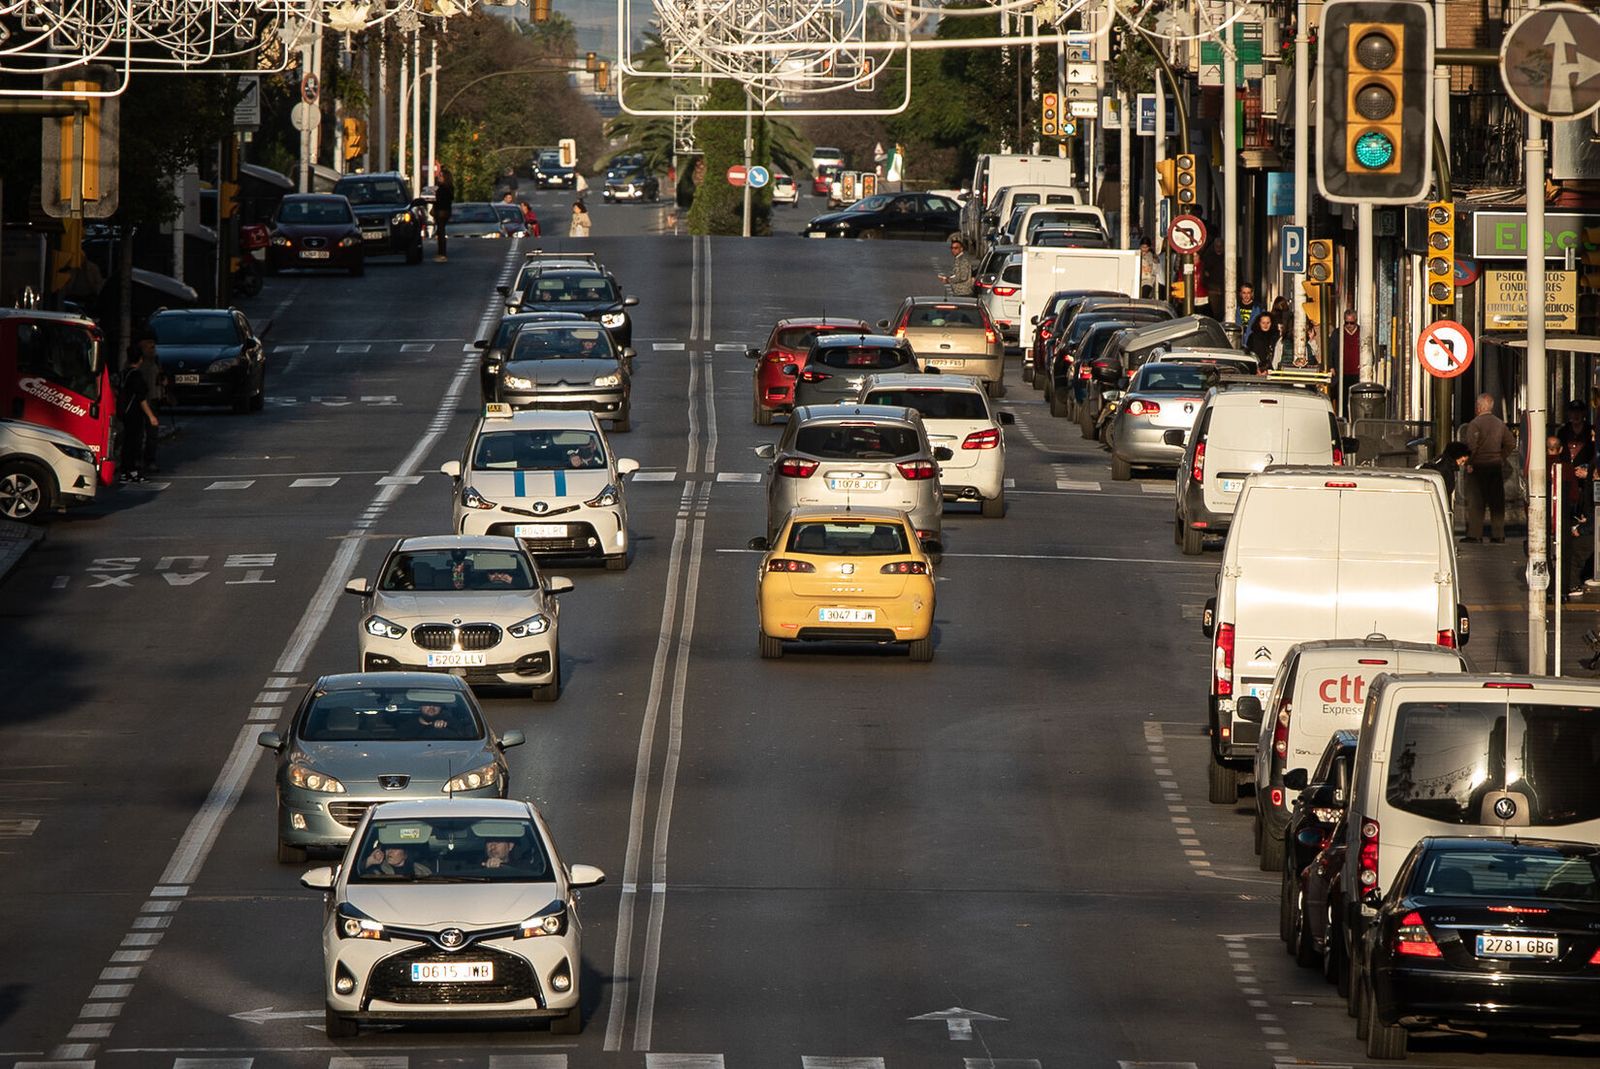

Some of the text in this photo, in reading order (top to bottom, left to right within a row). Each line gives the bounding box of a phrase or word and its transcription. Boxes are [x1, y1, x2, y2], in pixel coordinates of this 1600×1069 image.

[1495, 223, 1598, 251] Elec
[1286, 231, 1300, 267] P
[838, 480, 860, 488] 1078
[827, 608, 850, 620] 3047
[1319, 674, 1365, 704] ctt
[1322, 704, 1363, 716] Express
[1485, 938, 1554, 954] 2781 GBG
[422, 965, 489, 978] 0615 JWB
